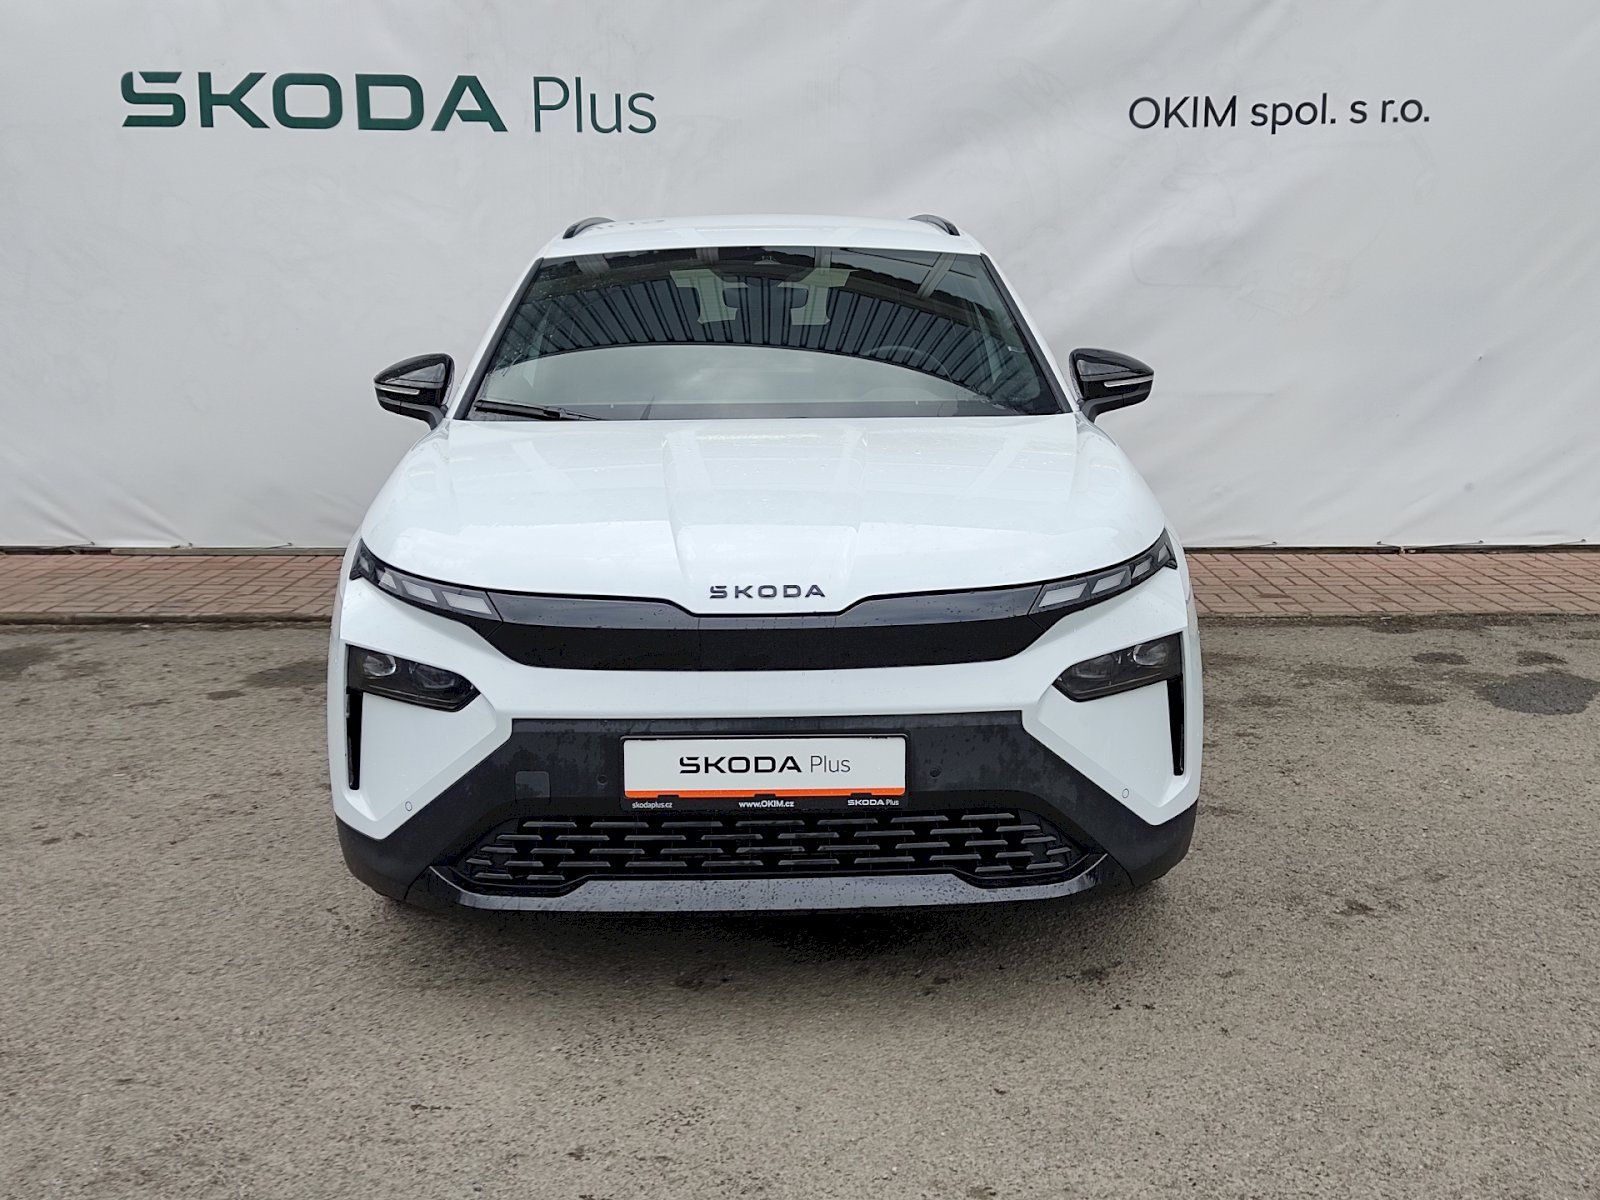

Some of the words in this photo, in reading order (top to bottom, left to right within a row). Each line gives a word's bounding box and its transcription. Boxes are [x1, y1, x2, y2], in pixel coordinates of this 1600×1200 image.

[532, 76, 657, 134] Plus
[1128, 95, 1237, 129] OKIM
[1250, 92, 1336, 135] spol.
[1349, 99, 1368, 124] s
[1380, 99, 1430, 123] r.o.
[810, 755, 851, 773] Plus
[631, 801, 673, 810] skodaplus.cz
[738, 799, 795, 808] www.OKIM.cz
[885, 798, 900, 806] Plus
